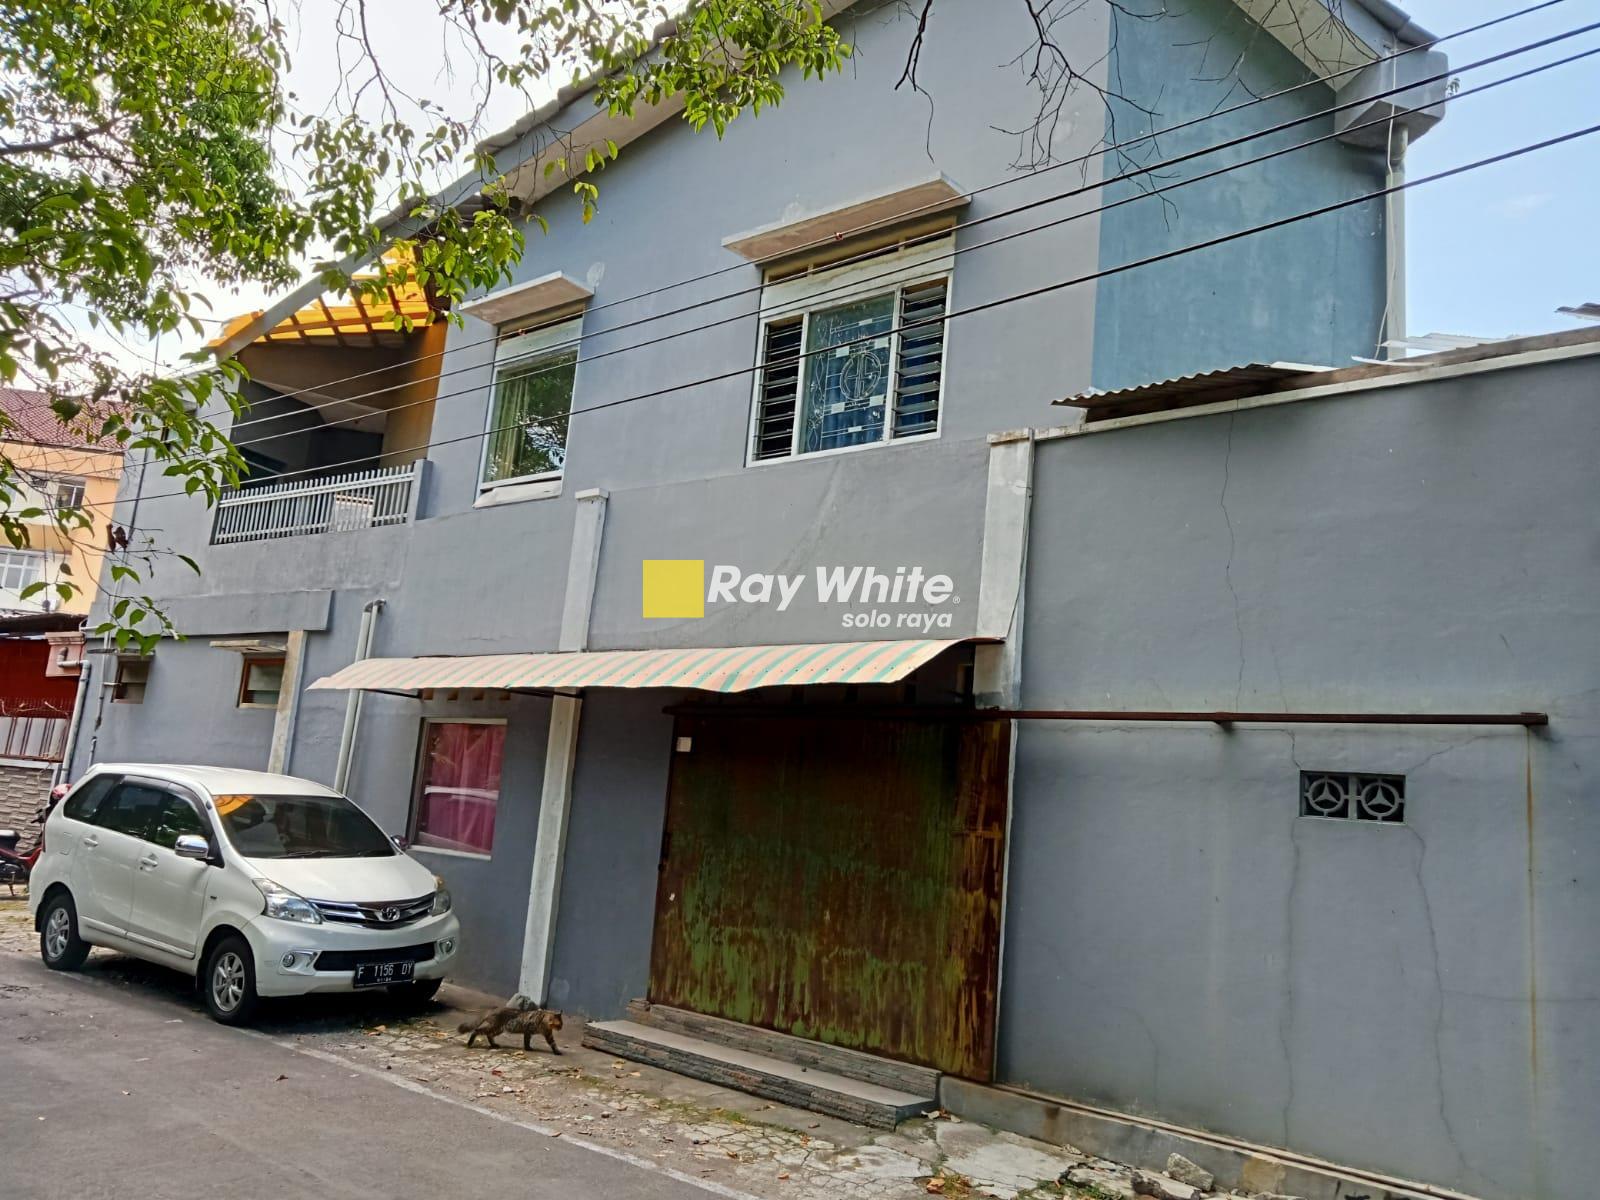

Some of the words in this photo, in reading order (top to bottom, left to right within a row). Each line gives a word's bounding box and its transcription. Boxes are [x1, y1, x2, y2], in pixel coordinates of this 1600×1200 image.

[358, 966, 365, 979] F
[374, 964, 395, 976] 1156
[402, 962, 413, 975] DY
